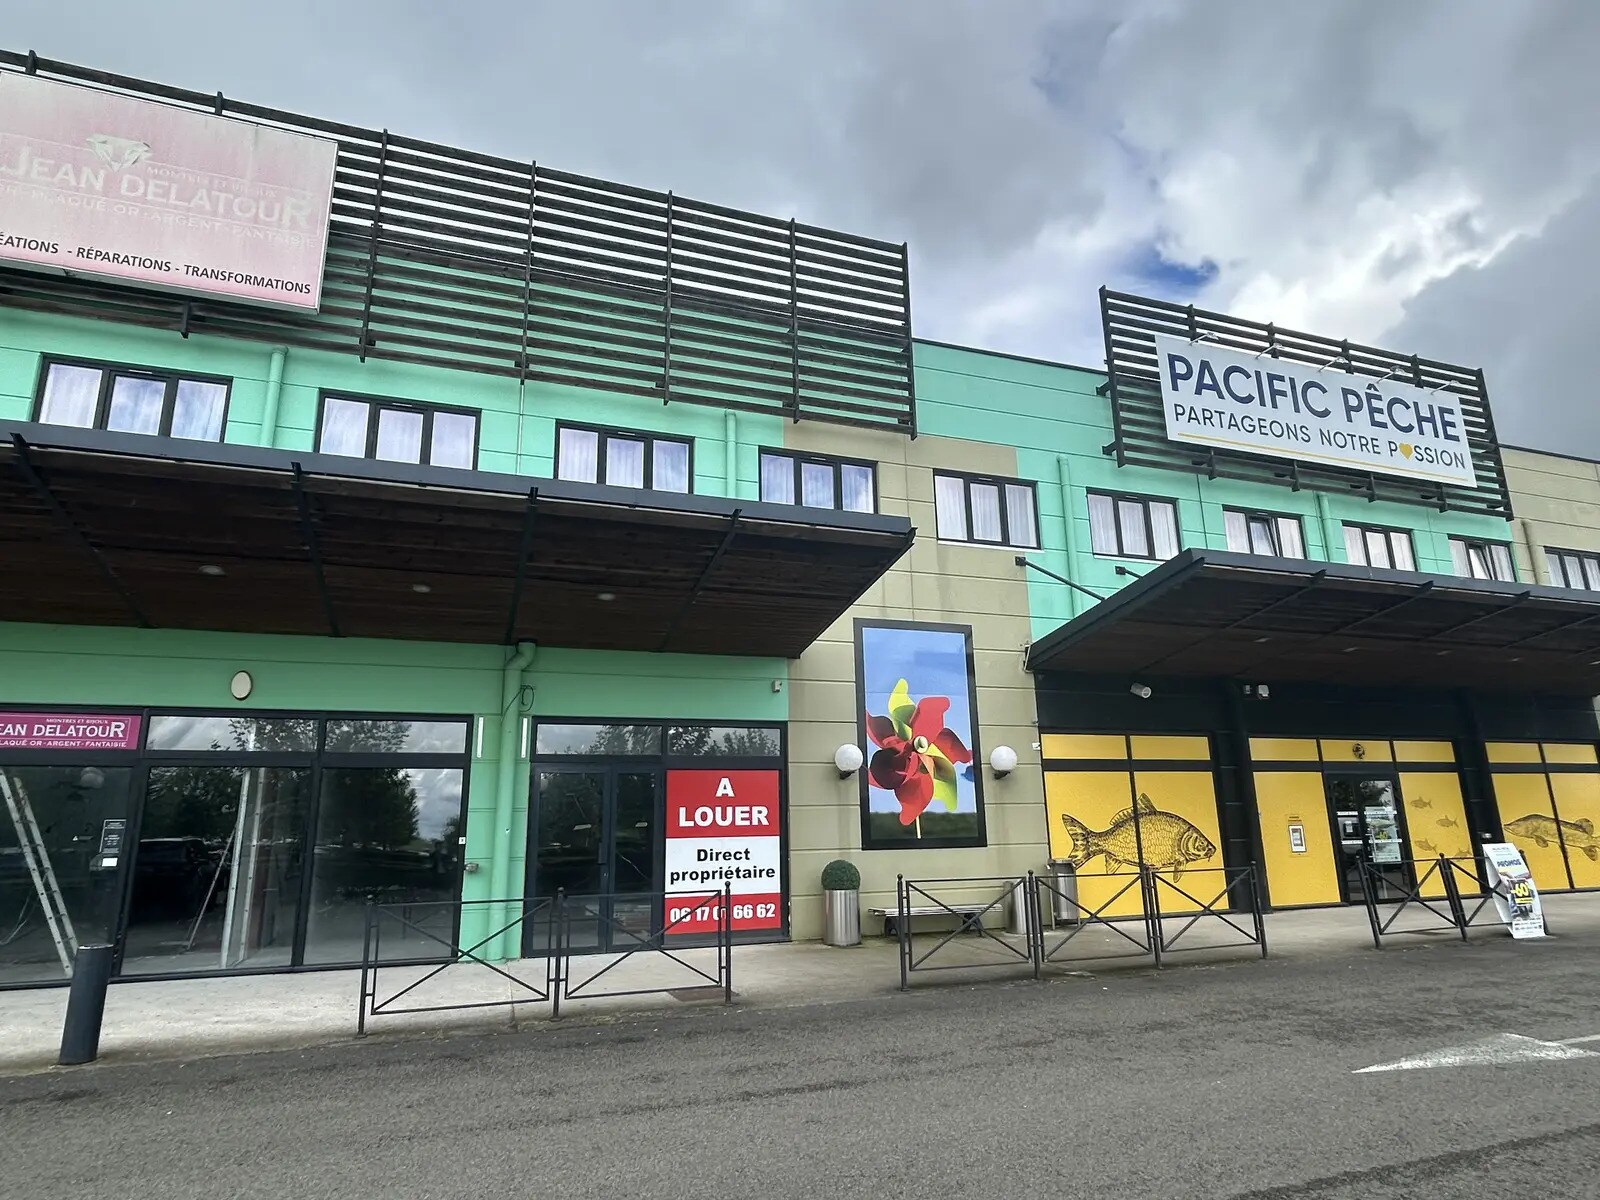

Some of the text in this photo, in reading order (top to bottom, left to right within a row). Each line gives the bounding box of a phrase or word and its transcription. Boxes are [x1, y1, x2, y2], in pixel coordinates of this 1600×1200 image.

[0, 146, 311, 231] JEAN DELATOUR
[76, 246, 172, 273] RÉPARATIONS
[184, 264, 311, 294] TRANSFORMATIONS
[1167, 352, 1461, 442] PACIFIC PÊCHE
[1173, 403, 1311, 443] PARTAGEONS
[1319, 429, 1381, 454] NOTRE
[33, 721, 125, 738] DELATOUR
[715, 777, 736, 798] A
[678, 806, 770, 827] LOUER
[697, 848, 751, 862] Direct
[670, 865, 776, 884] propriétaire
[733, 903, 754, 919] 66
[756, 902, 776, 918] 62
